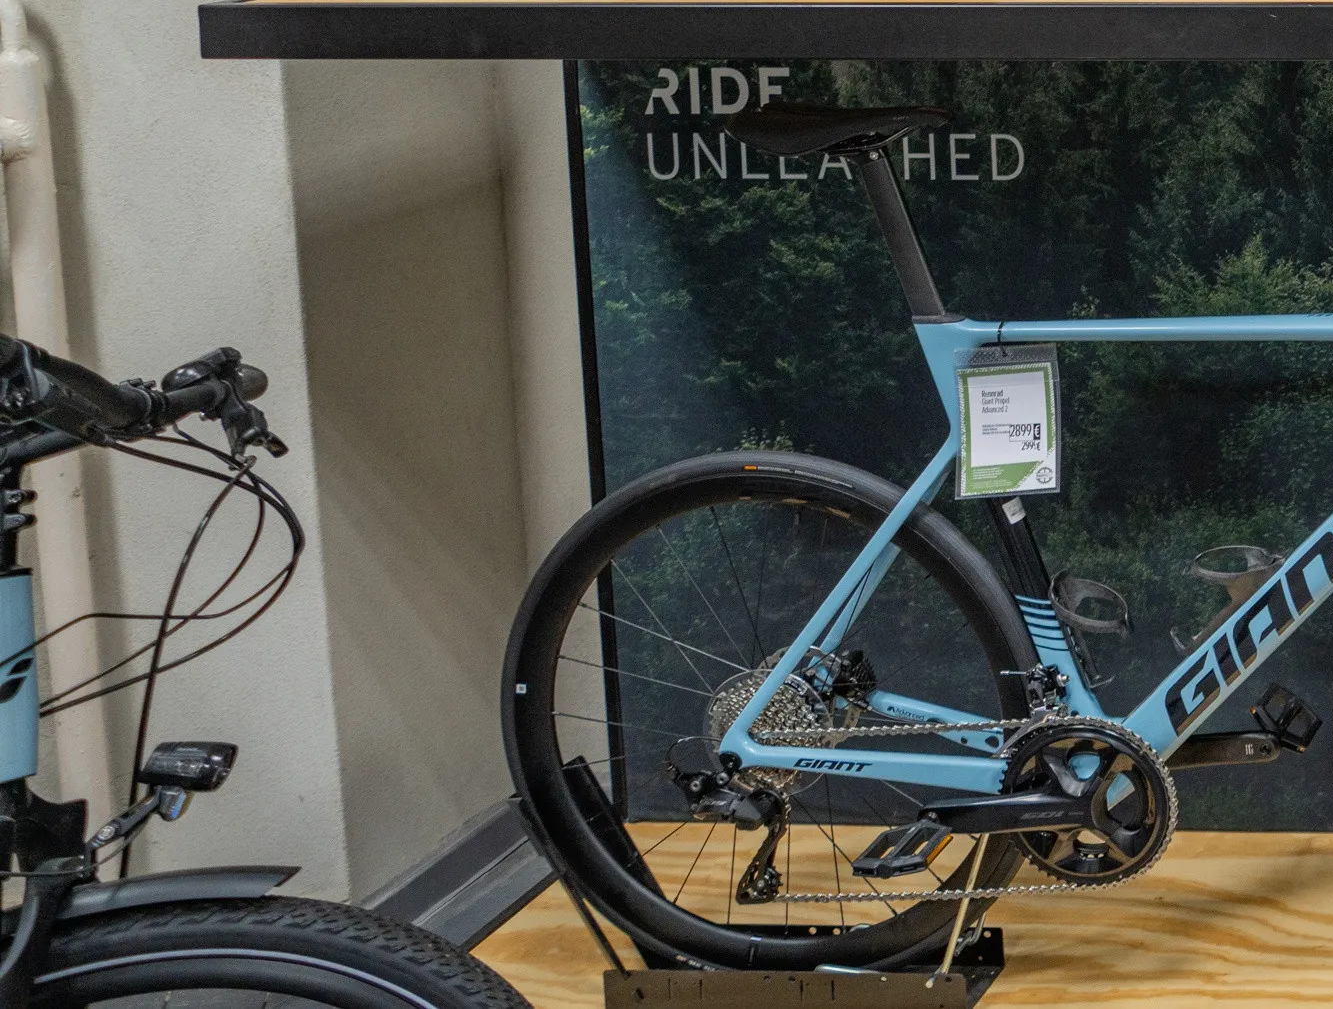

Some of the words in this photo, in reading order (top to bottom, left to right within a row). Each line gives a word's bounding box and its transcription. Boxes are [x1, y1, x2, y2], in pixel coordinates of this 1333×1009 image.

[645, 67, 790, 115] RIDE
[981, 390, 1003, 398] Rennrad
[982, 406, 1004, 414] Advanced
[1009, 424, 1032, 438] 2899
[793, 757, 873, 772] GIANT
